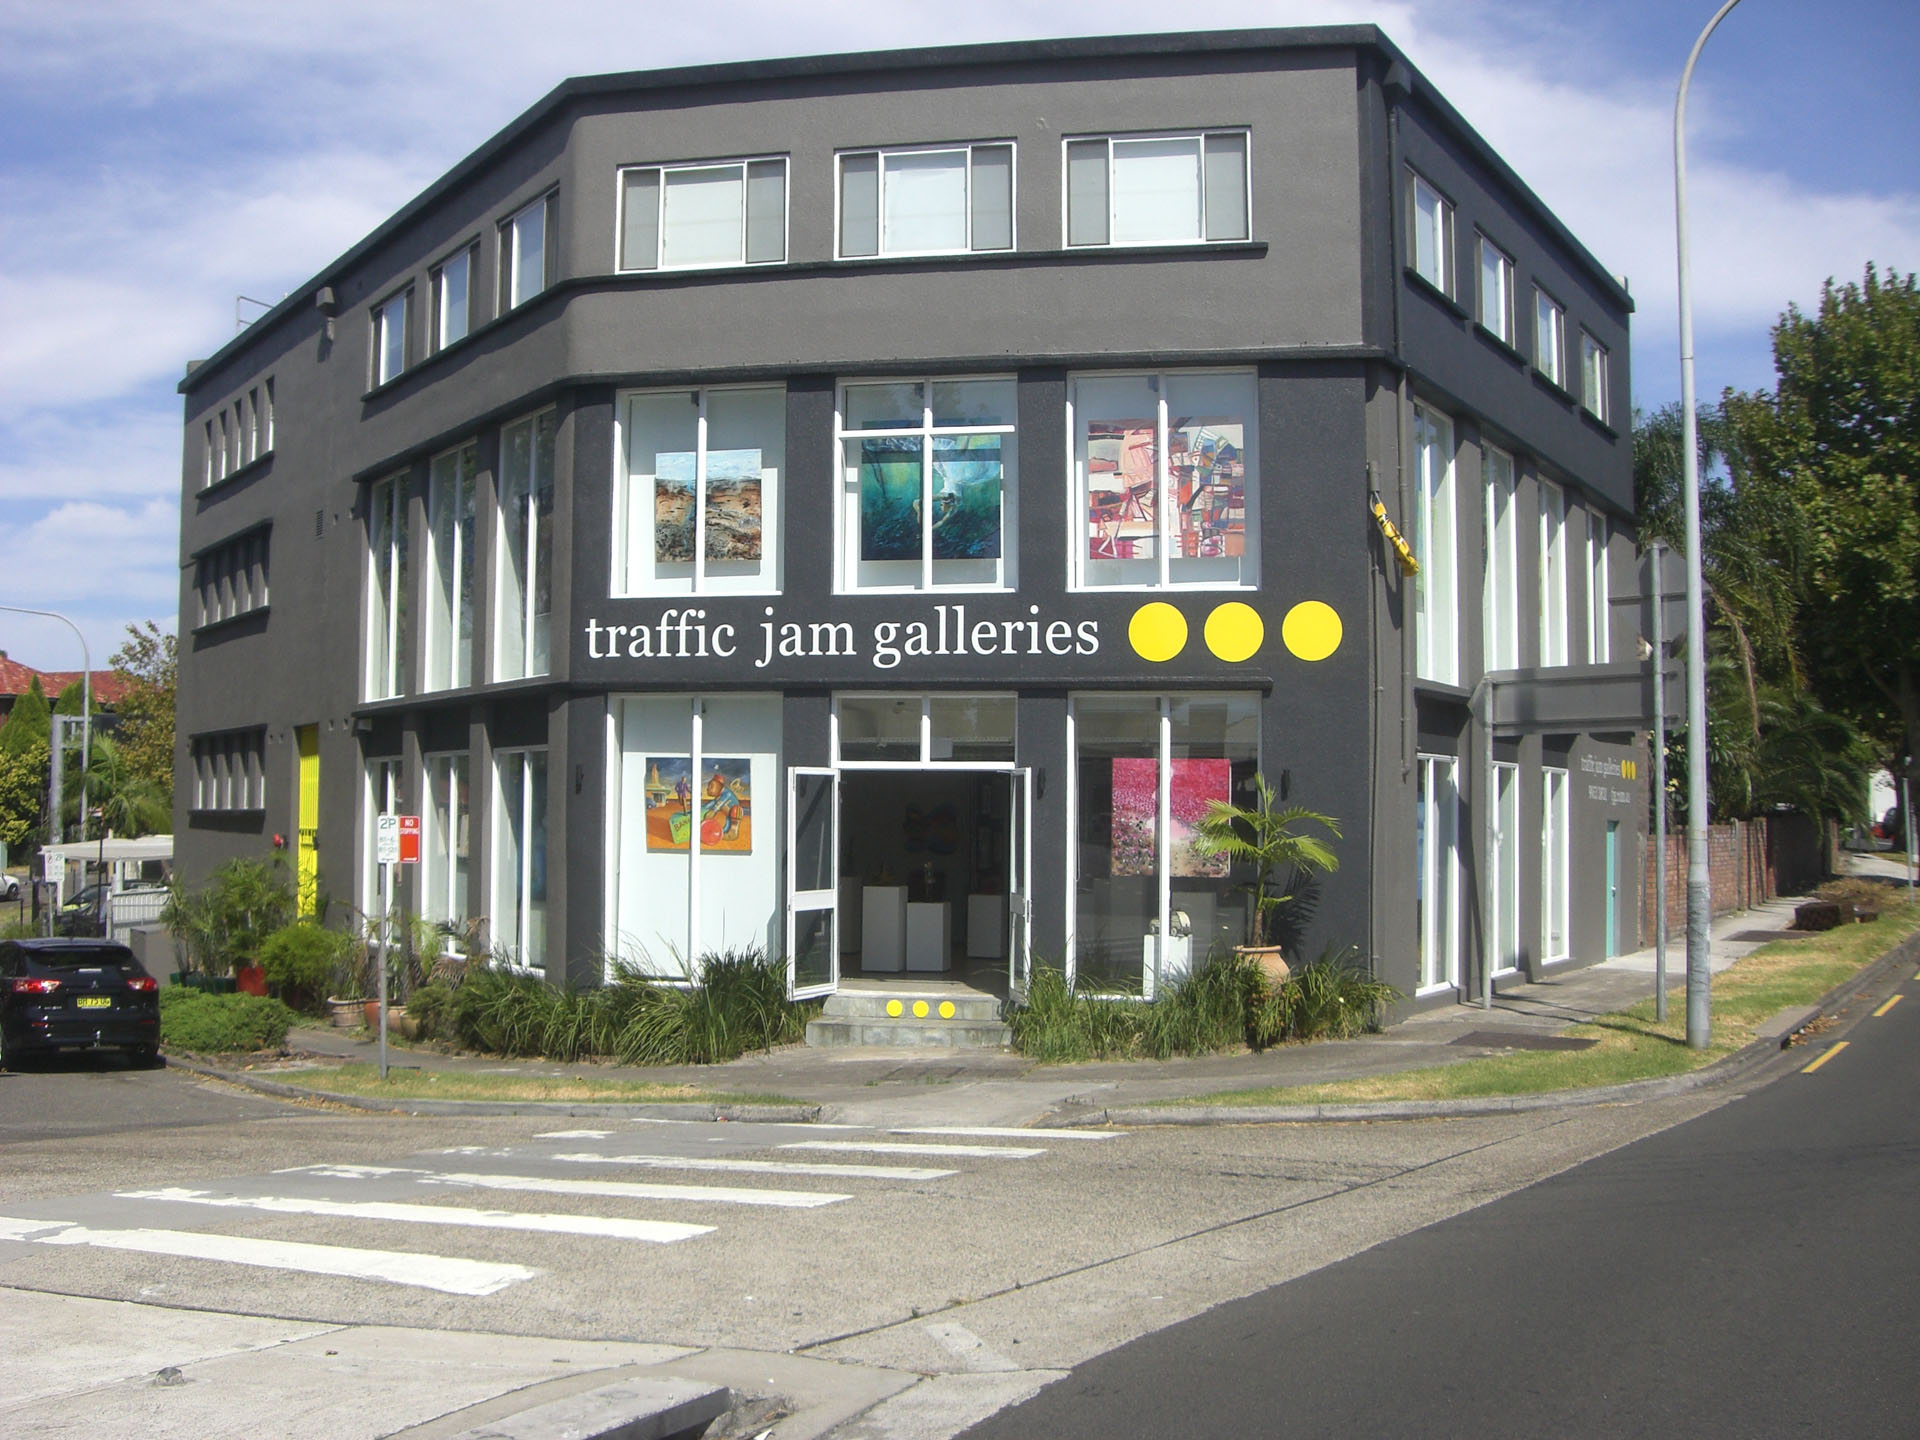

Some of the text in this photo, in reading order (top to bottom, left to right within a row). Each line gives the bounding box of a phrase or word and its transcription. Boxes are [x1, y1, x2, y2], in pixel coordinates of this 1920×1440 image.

[584, 604, 1100, 669] traffic jam galleries
[380, 818, 396, 829] 2P
[405, 819, 414, 827] NO
